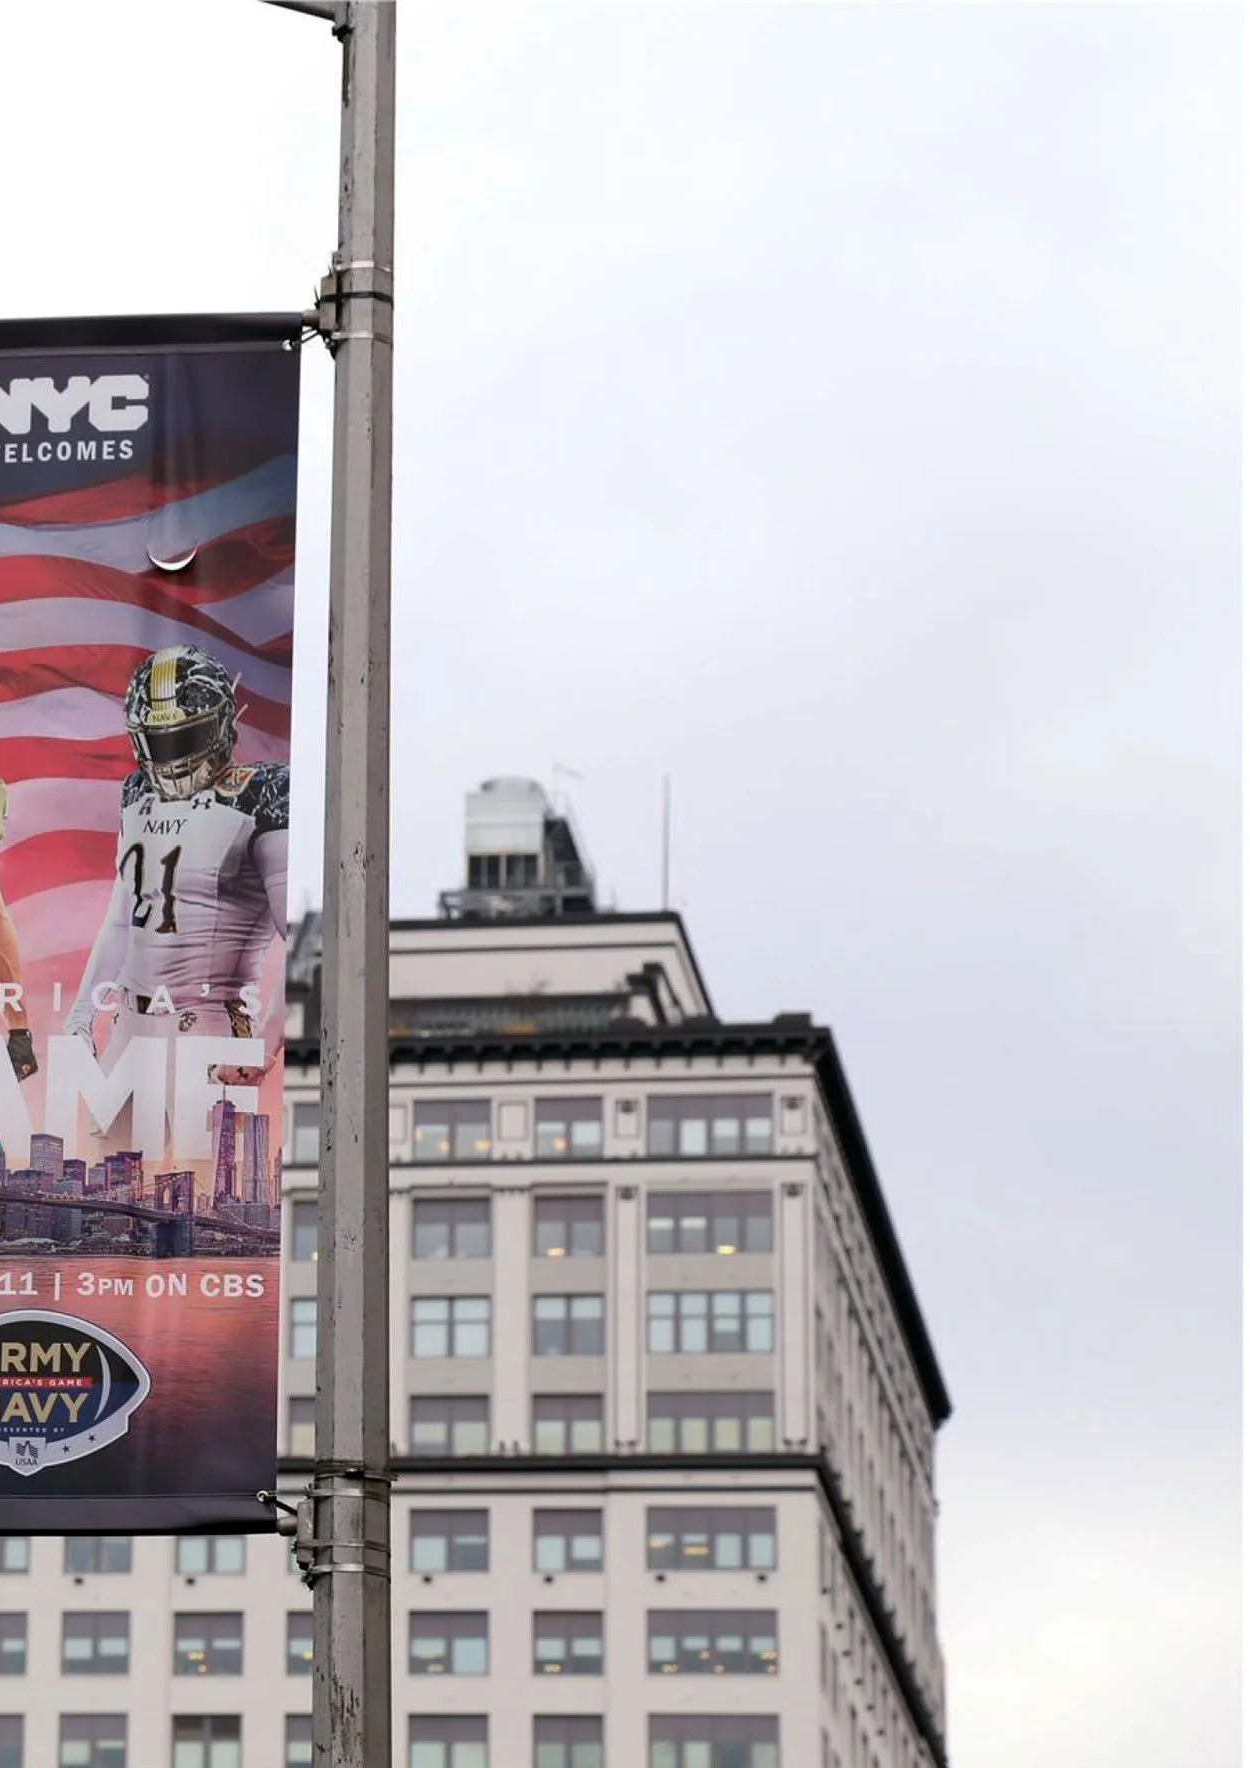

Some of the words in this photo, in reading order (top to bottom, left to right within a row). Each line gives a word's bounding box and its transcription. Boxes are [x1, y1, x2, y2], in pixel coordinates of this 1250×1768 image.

[152, 711, 180, 721] NAVY
[143, 818, 187, 835] NAVY
[76, 1272, 134, 1297] 3PM
[145, 1273, 187, 1298] ON
[200, 1273, 265, 1298] CBS
[49, 1378, 83, 1388] GAME
[15, 1457, 38, 1467] USAA
